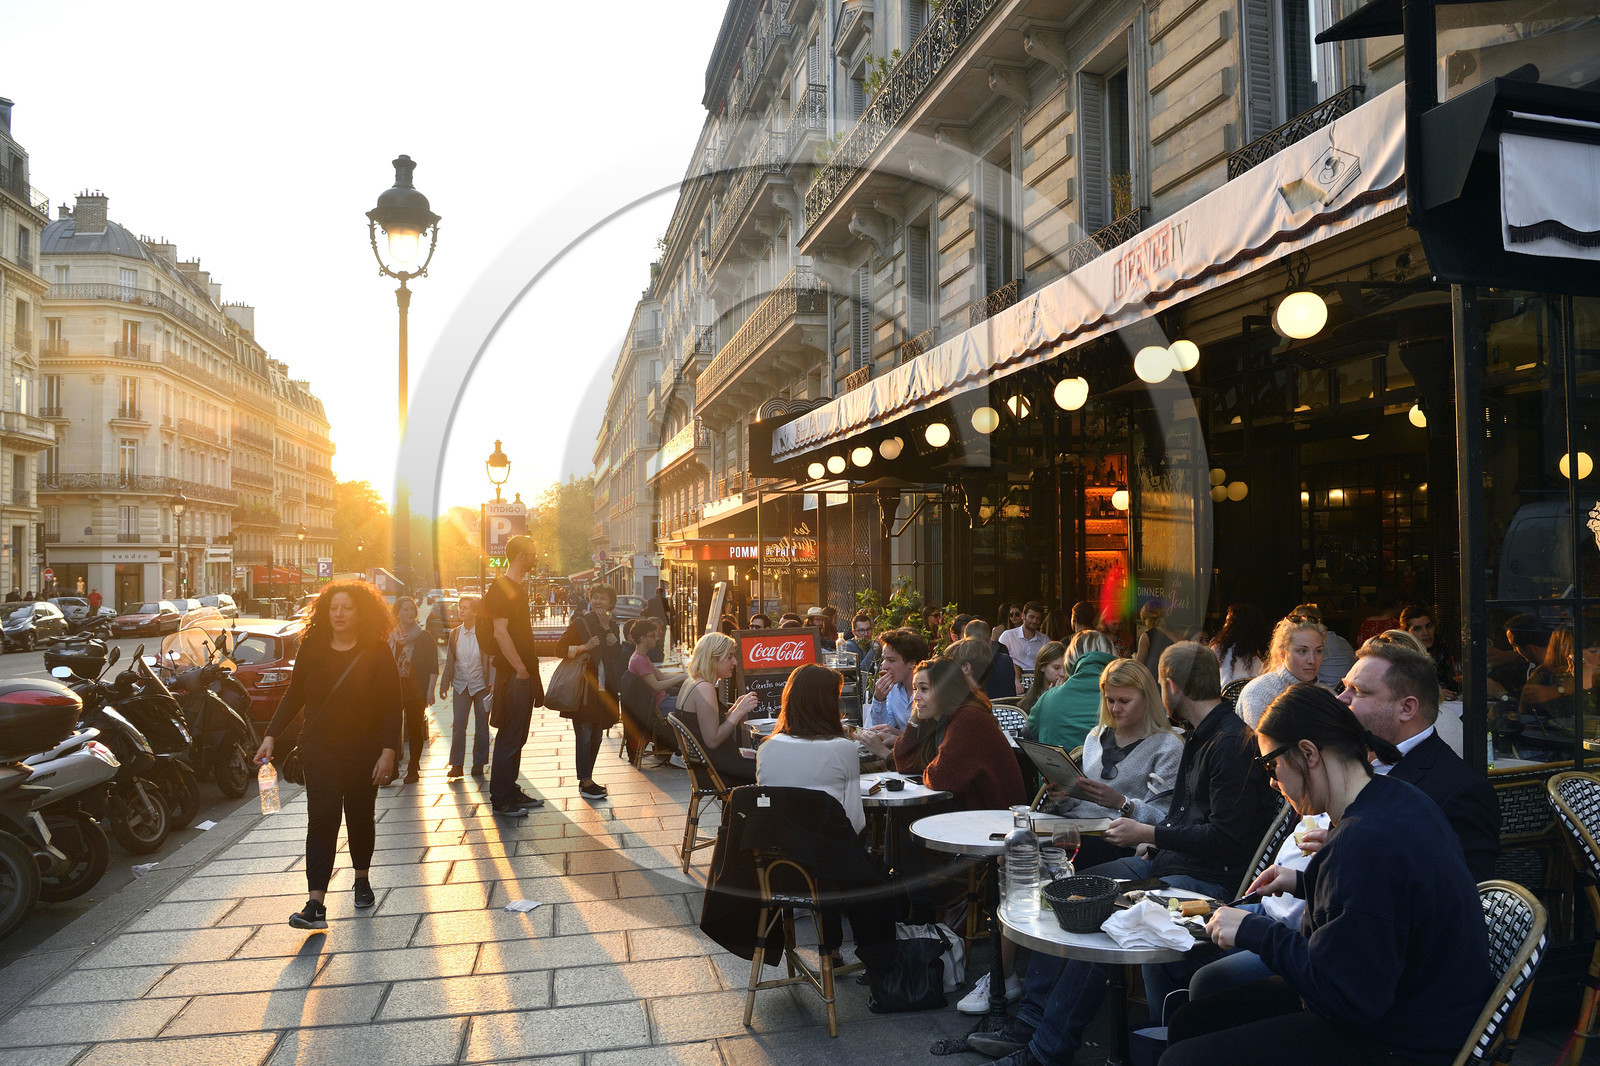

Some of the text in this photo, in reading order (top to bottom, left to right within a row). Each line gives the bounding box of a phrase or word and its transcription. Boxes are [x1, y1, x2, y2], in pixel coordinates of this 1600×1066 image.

[1171, 219, 1190, 264] IV
[490, 506, 521, 514] INDIGO
[490, 517, 512, 545] P
[729, 546, 758, 558] POMM
[319, 563, 328, 573] P
[488, 557, 509, 567] 24/
[1137, 586, 1166, 597] DINNER
[1167, 590, 1190, 617] Jour
[749, 640, 806, 662] Coca-Cola
